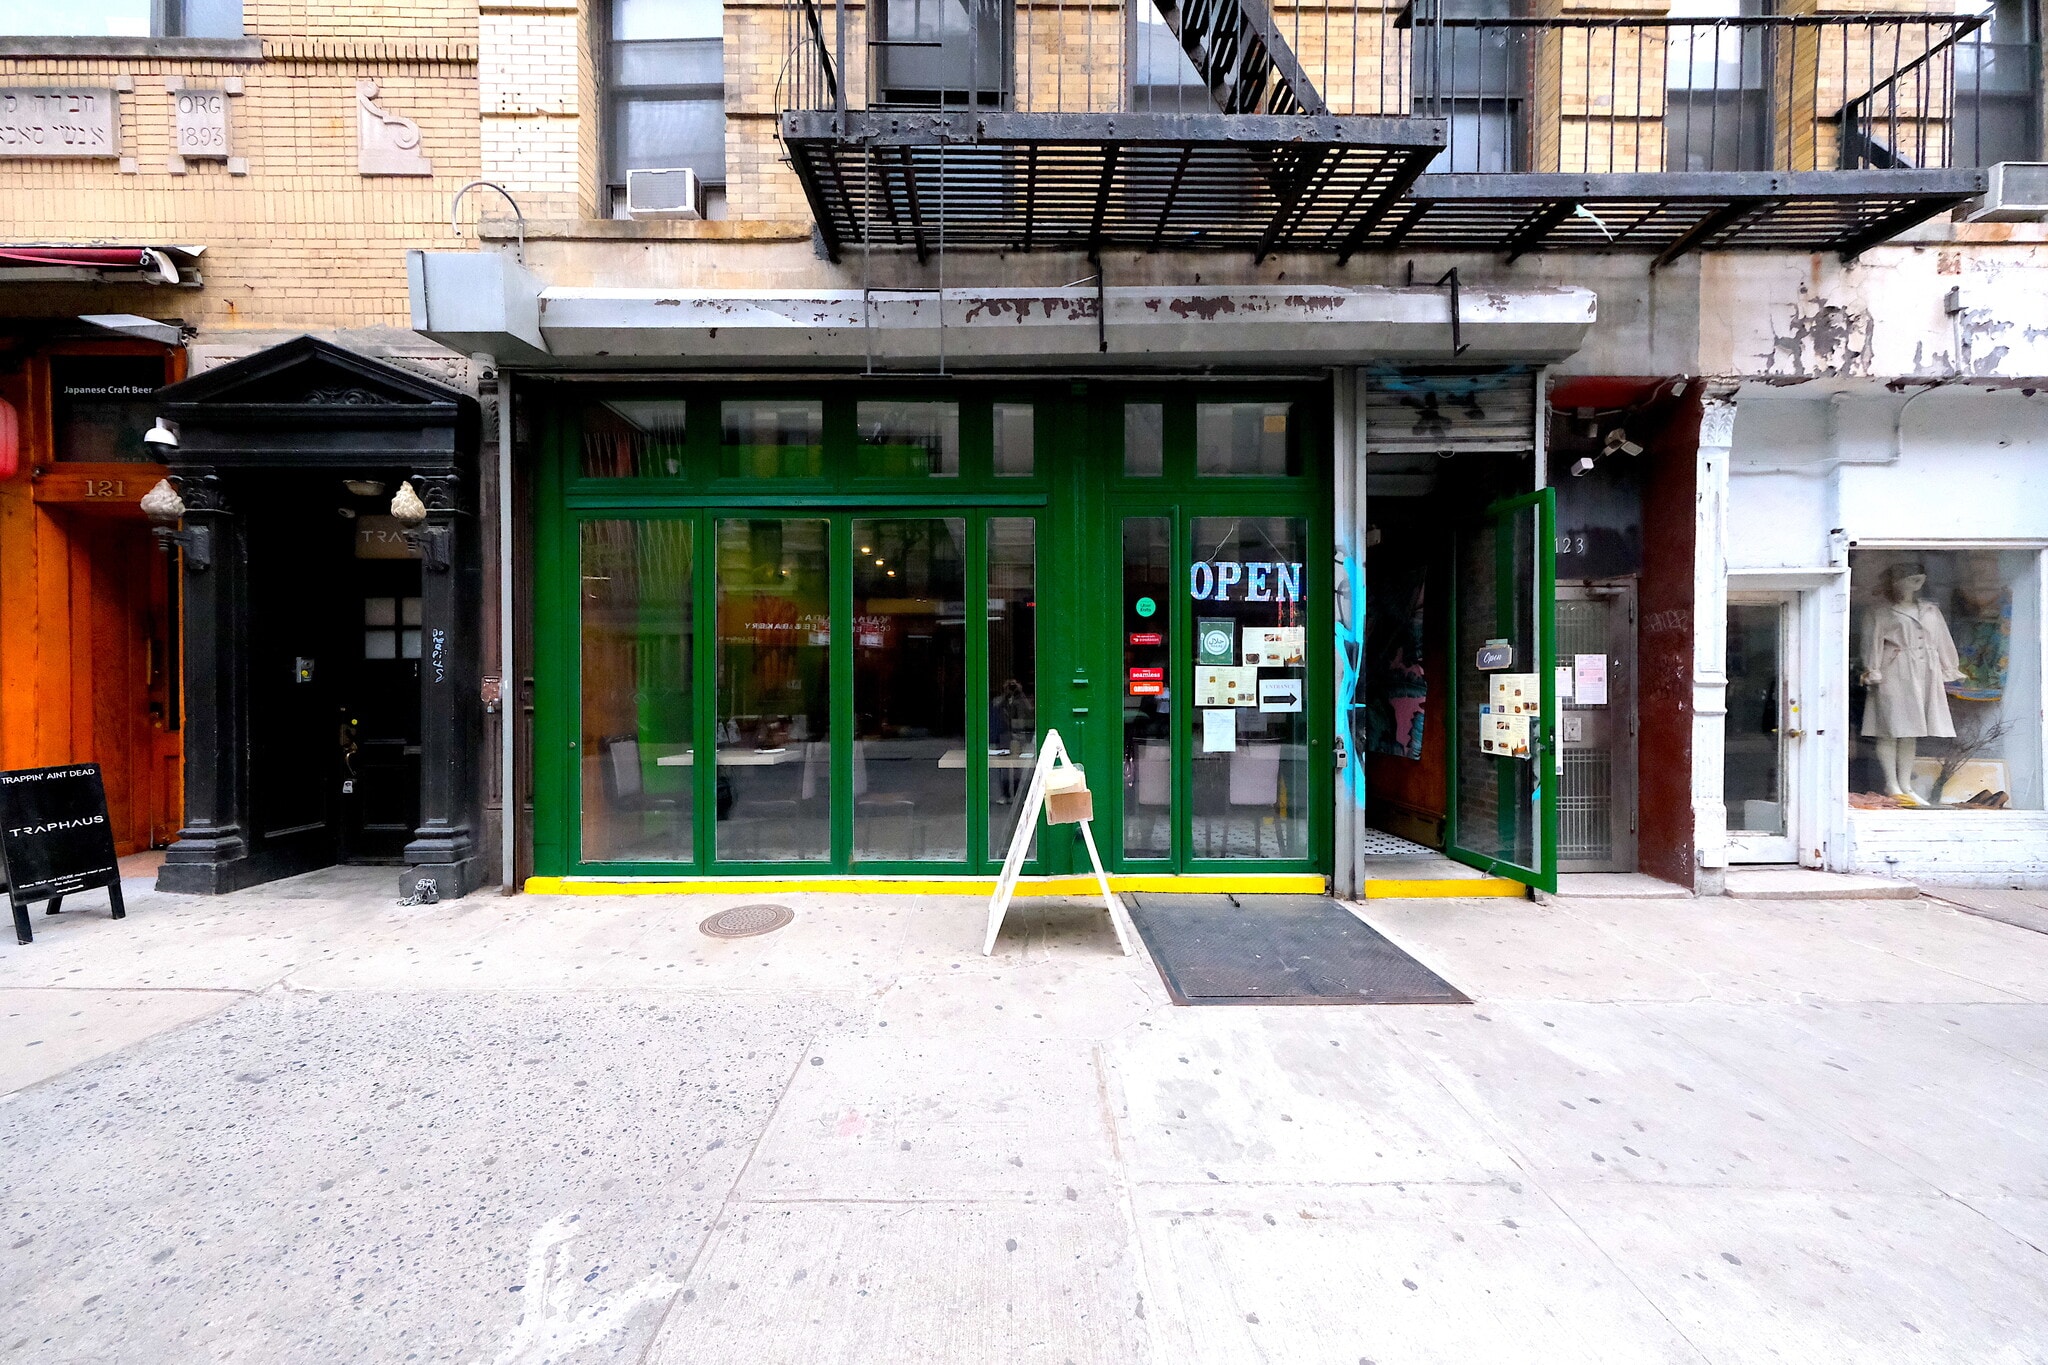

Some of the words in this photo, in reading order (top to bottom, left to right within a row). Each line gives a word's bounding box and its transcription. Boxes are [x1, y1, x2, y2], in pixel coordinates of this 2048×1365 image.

[180, 96, 221, 114] ORG
[180, 127, 224, 147] 1893
[64, 386, 106, 395] Japanese
[107, 386, 130, 394] Craft
[132, 386, 153, 394] Beer
[85, 480, 126, 497] 121
[1555, 537, 1584, 554] 123
[1190, 561, 1303, 602] OPEN
[1483, 652, 1502, 664] Open
[47, 771, 67, 780] AINT
[69, 768, 95, 777] DEAD
[9, 815, 104, 837] TRAPHAUS
